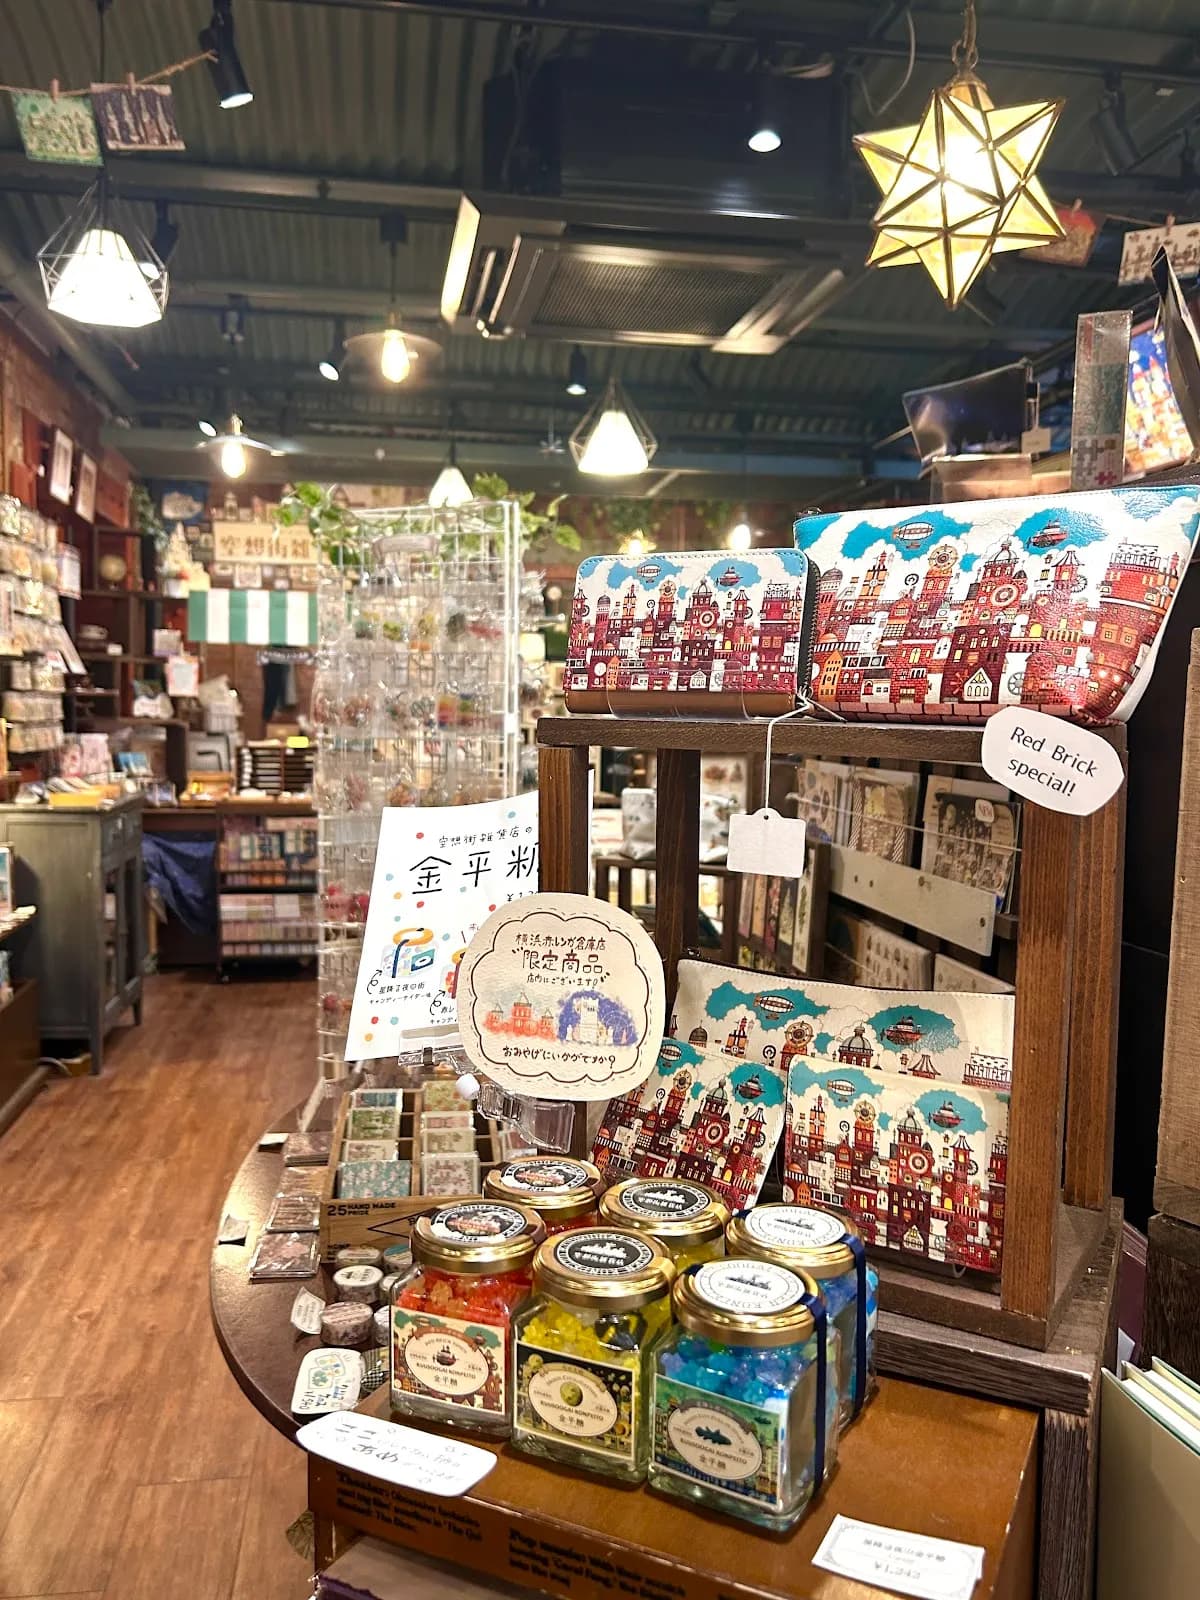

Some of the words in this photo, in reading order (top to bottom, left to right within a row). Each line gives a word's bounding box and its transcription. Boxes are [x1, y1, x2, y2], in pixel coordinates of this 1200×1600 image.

[1010, 726, 1046, 752] Red
[1051, 745, 1098, 777] Brick
[1008, 758, 1076, 797] special!
[515, 934, 606, 951] 横浜赤レンガ倉庫店
[523, 949, 603, 974] 限定商品
[327, 1205, 347, 1216] 25
